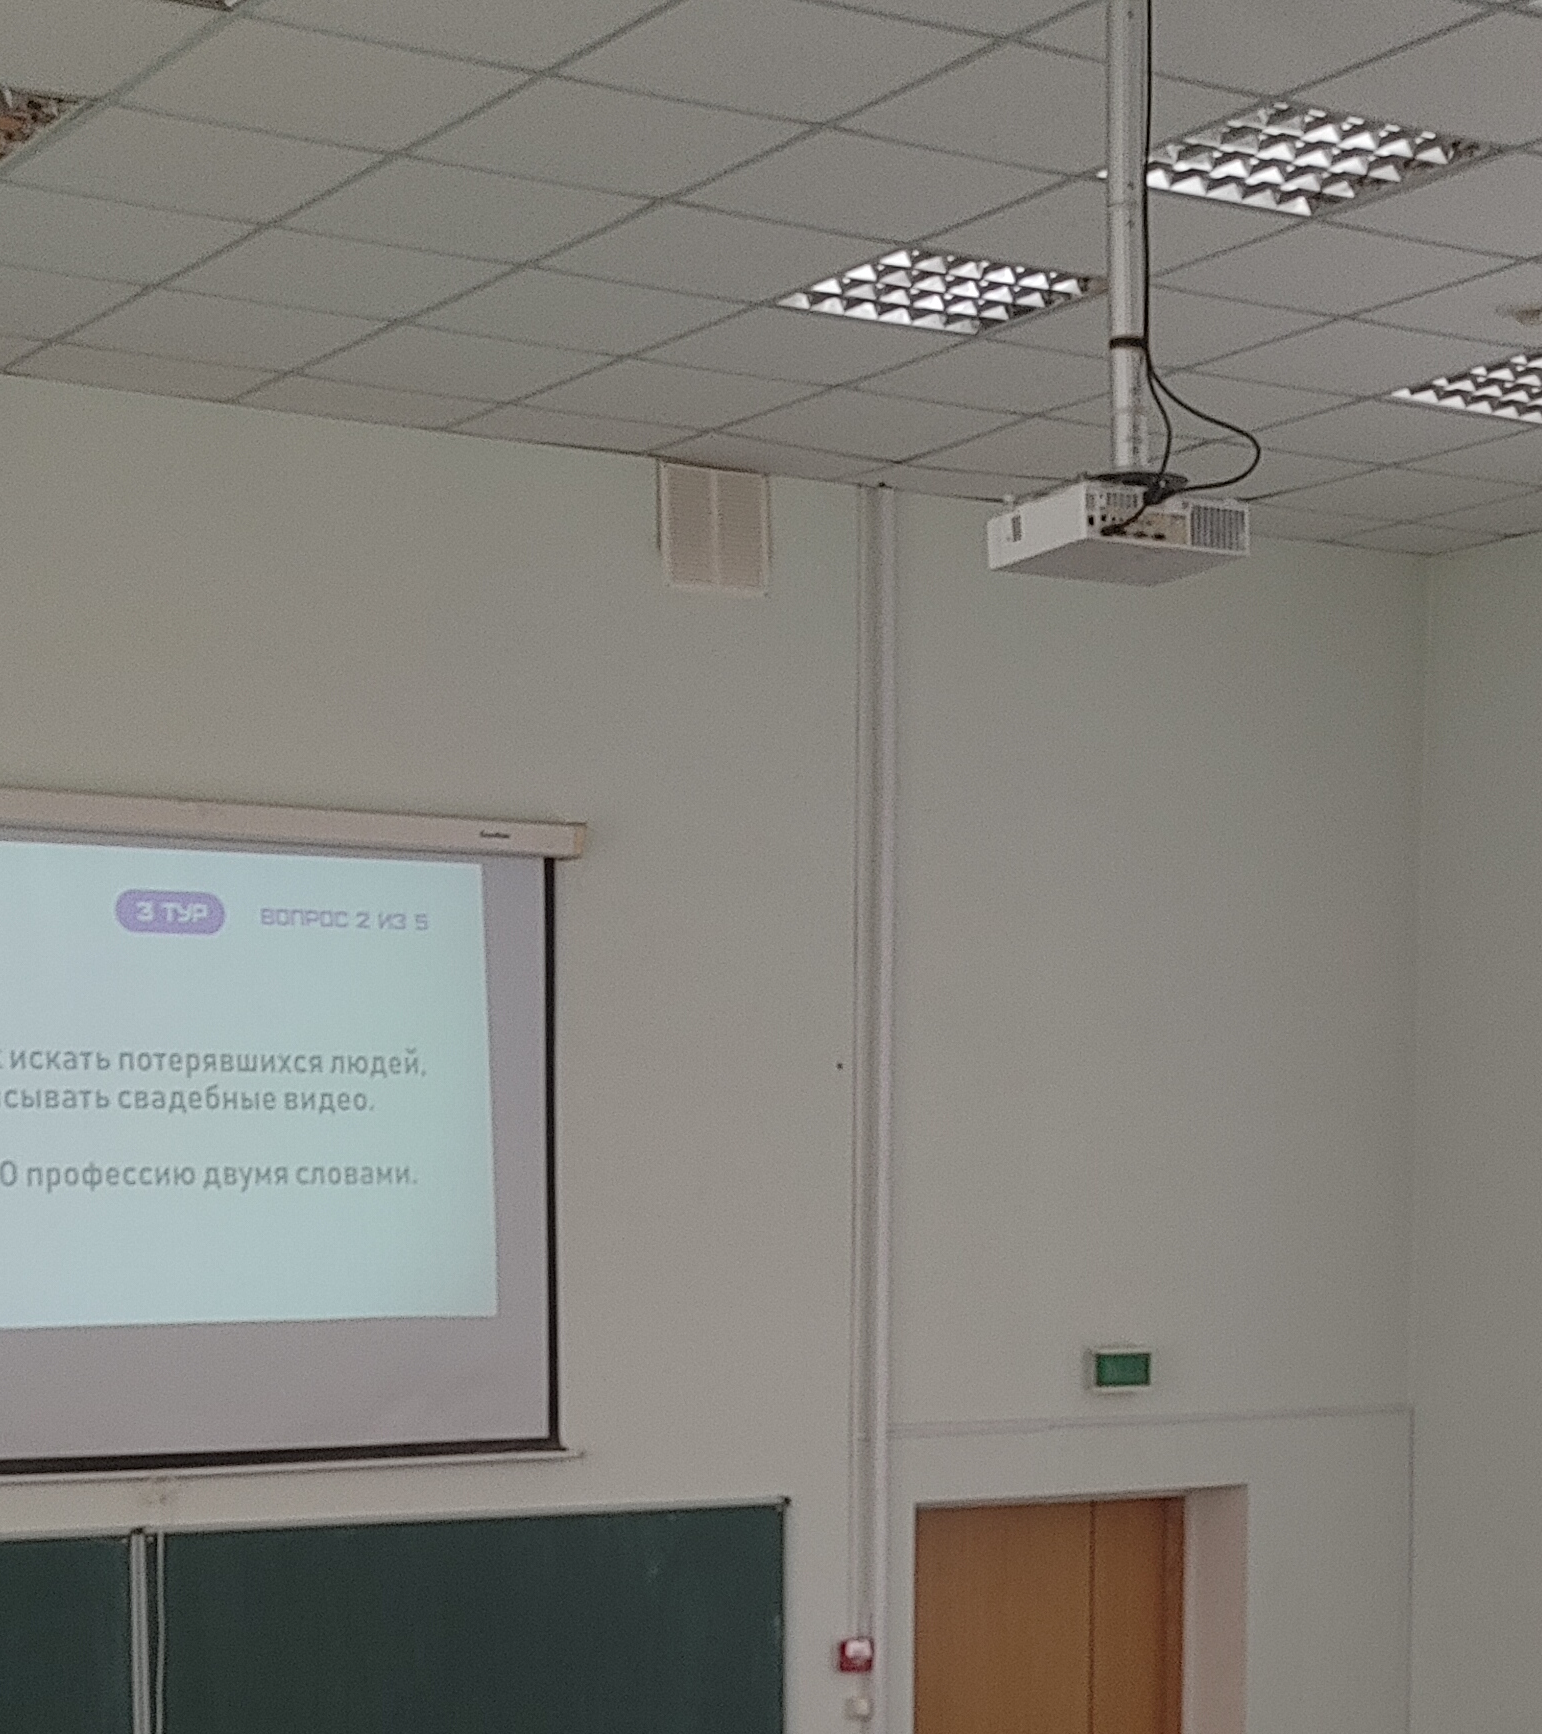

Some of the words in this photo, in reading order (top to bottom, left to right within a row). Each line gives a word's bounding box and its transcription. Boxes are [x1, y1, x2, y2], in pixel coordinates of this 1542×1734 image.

[162, 901, 208, 923] ТУР
[260, 908, 349, 928] ВОПРОС
[356, 911, 370, 929] 2
[378, 912, 406, 930] ИЗ
[415, 913, 429, 931] 5
[10, 1049, 110, 1071] искать
[118, 1051, 324, 1078] потерявшихся
[330, 1047, 427, 1078] людей,
[117, 1084, 277, 1114] свадебные
[284, 1090, 375, 1114] видео.
[26, 1161, 196, 1193] профессию
[202, 1165, 289, 1192] двумя
[295, 1165, 419, 1186] словами.
